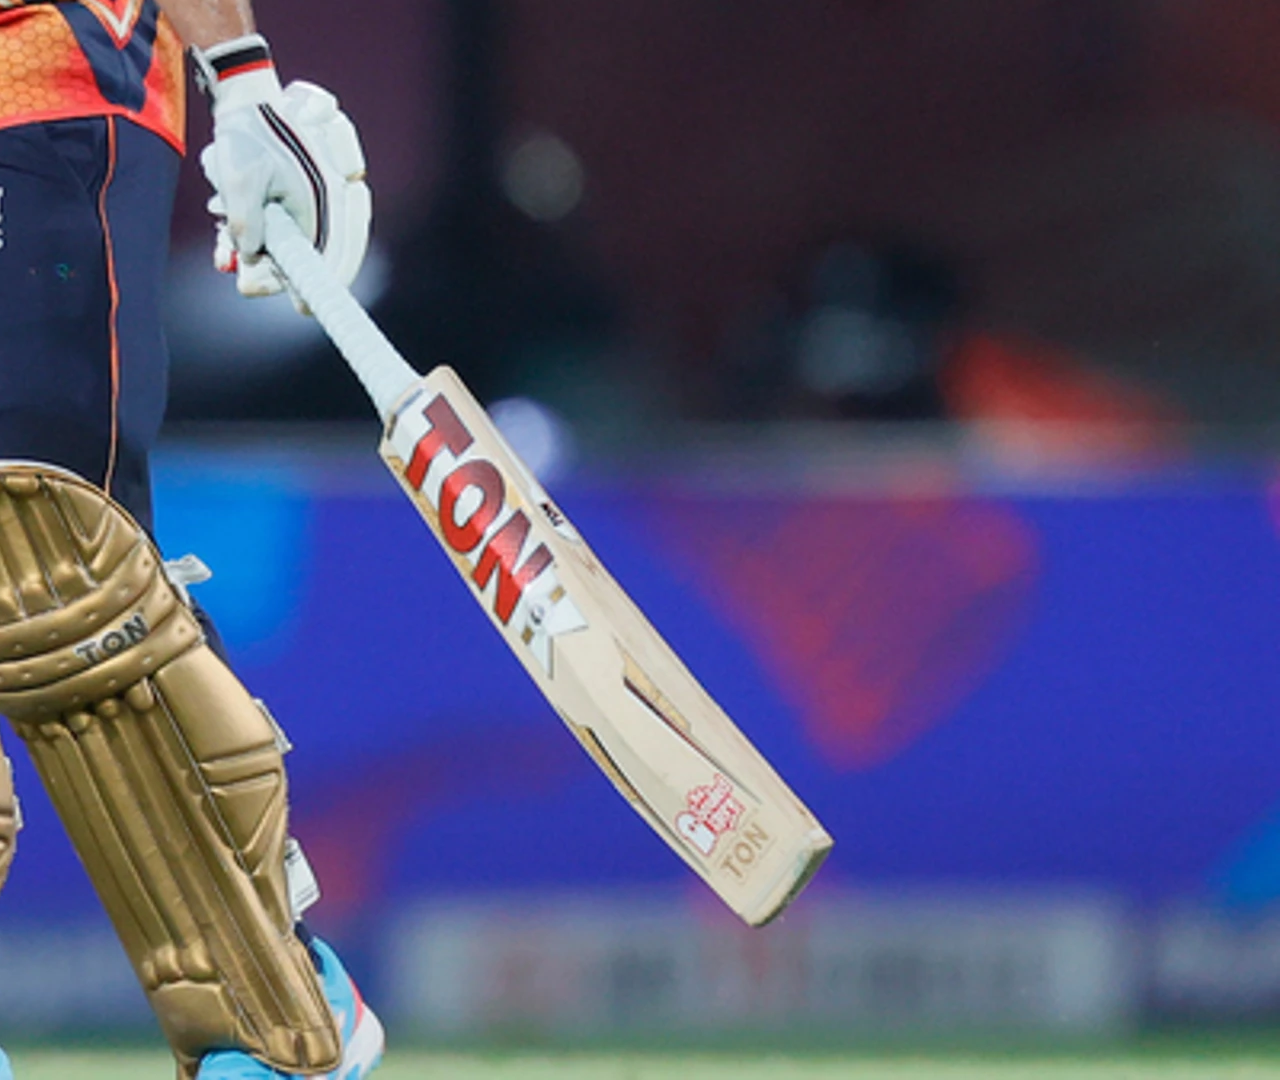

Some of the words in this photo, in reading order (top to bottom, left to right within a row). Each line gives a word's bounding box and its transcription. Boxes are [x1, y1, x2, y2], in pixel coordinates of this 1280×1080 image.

[405, 392, 554, 626] TON
[76, 614, 149, 664] TON
[720, 822, 769, 879] TON
